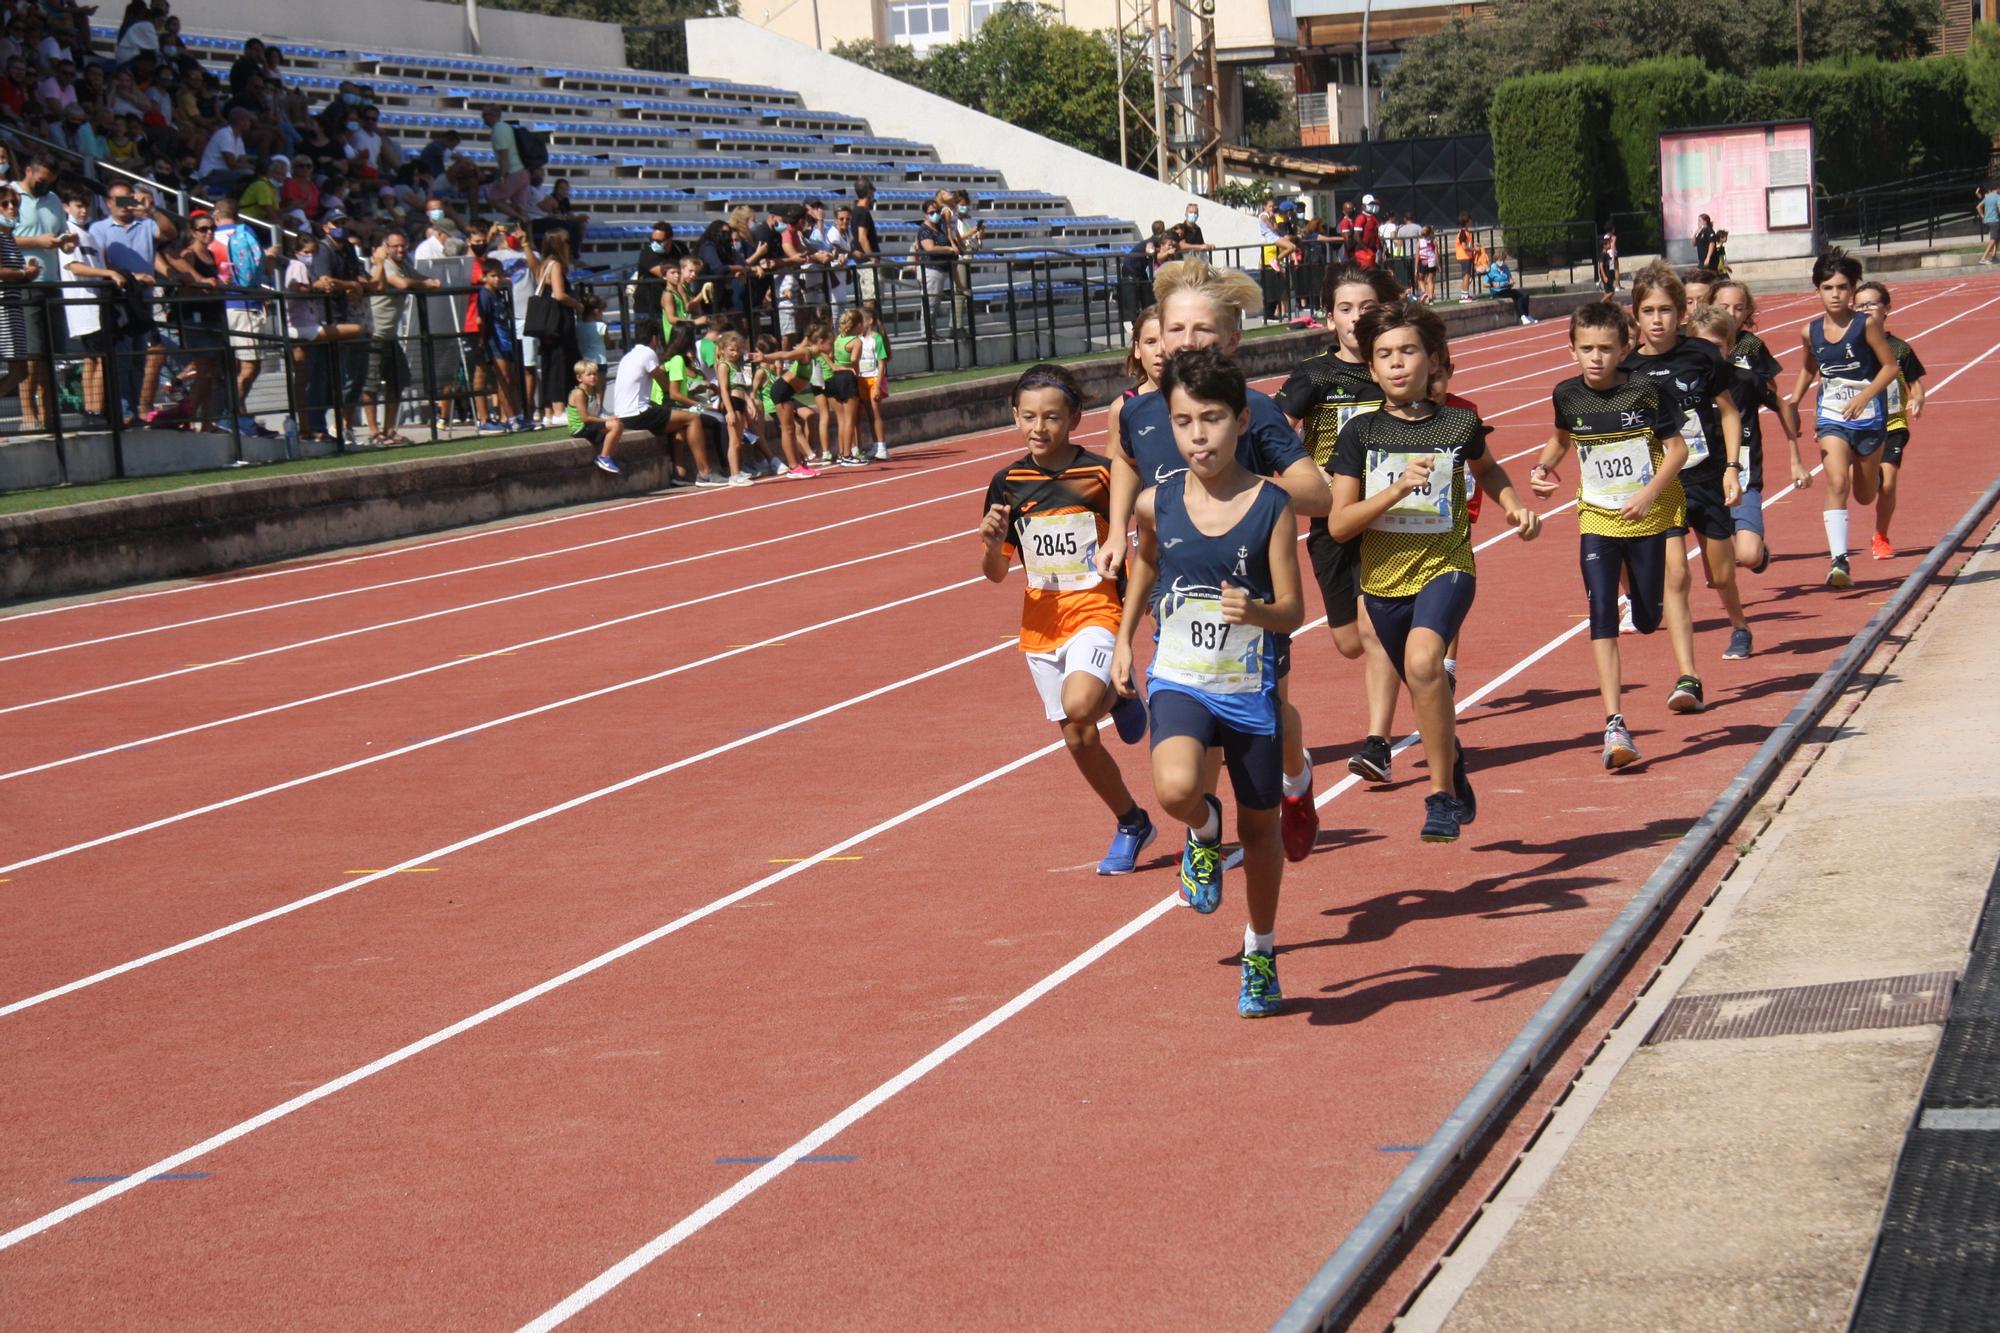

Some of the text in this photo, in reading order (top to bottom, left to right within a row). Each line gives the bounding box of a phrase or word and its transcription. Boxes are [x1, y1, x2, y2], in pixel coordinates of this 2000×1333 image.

[1595, 456, 1634, 479] 1328
[1033, 532, 1077, 557] 2845
[1191, 620, 1231, 651] 837
[1090, 647, 1107, 669] 10
